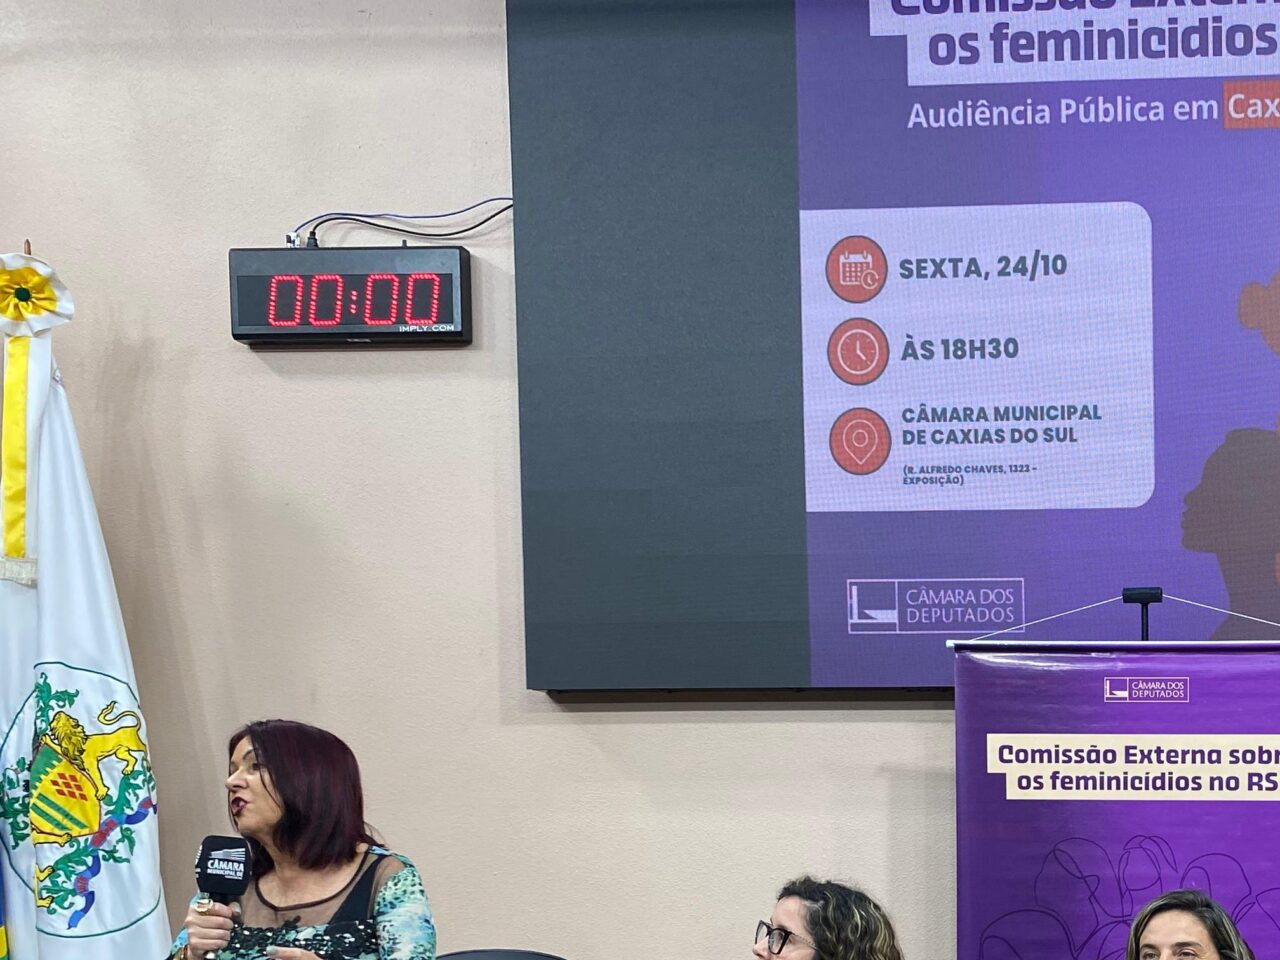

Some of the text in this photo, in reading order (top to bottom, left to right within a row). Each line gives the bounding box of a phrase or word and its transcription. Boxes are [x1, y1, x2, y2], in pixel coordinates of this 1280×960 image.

[928, 32, 980, 65] os
[990, 15, 1278, 64] feminicidios
[907, 99, 1050, 129] Audiência
[1060, 95, 1165, 124] Pública
[1173, 99, 1218, 121] em
[899, 249, 1068, 282] SEXTA, 24/10
[268, 273, 441, 327] 00:00
[900, 334, 1019, 361] ÀS 18H30
[901, 403, 1102, 423] CÂMARA MUNICIPAL
[902, 427, 1078, 445] DE CAXIAS DO SUL
[919, 465, 962, 475] ALFREDO
[964, 464, 1007, 474] CHAVES,
[1009, 463, 1030, 473] 1323
[903, 474, 964, 487] EXPOSIÇÃO)
[906, 586, 1014, 605] CÂMARA DOS
[907, 607, 1015, 623] DEPUTADOS
[1131, 680, 1184, 690] CÂMARA DOS
[1132, 690, 1185, 698] DEPUTADOS
[998, 744, 1117, 765] Comissão
[1124, 745, 1222, 765] Externa
[1016, 771, 1279, 792] os feminicídios no RS
